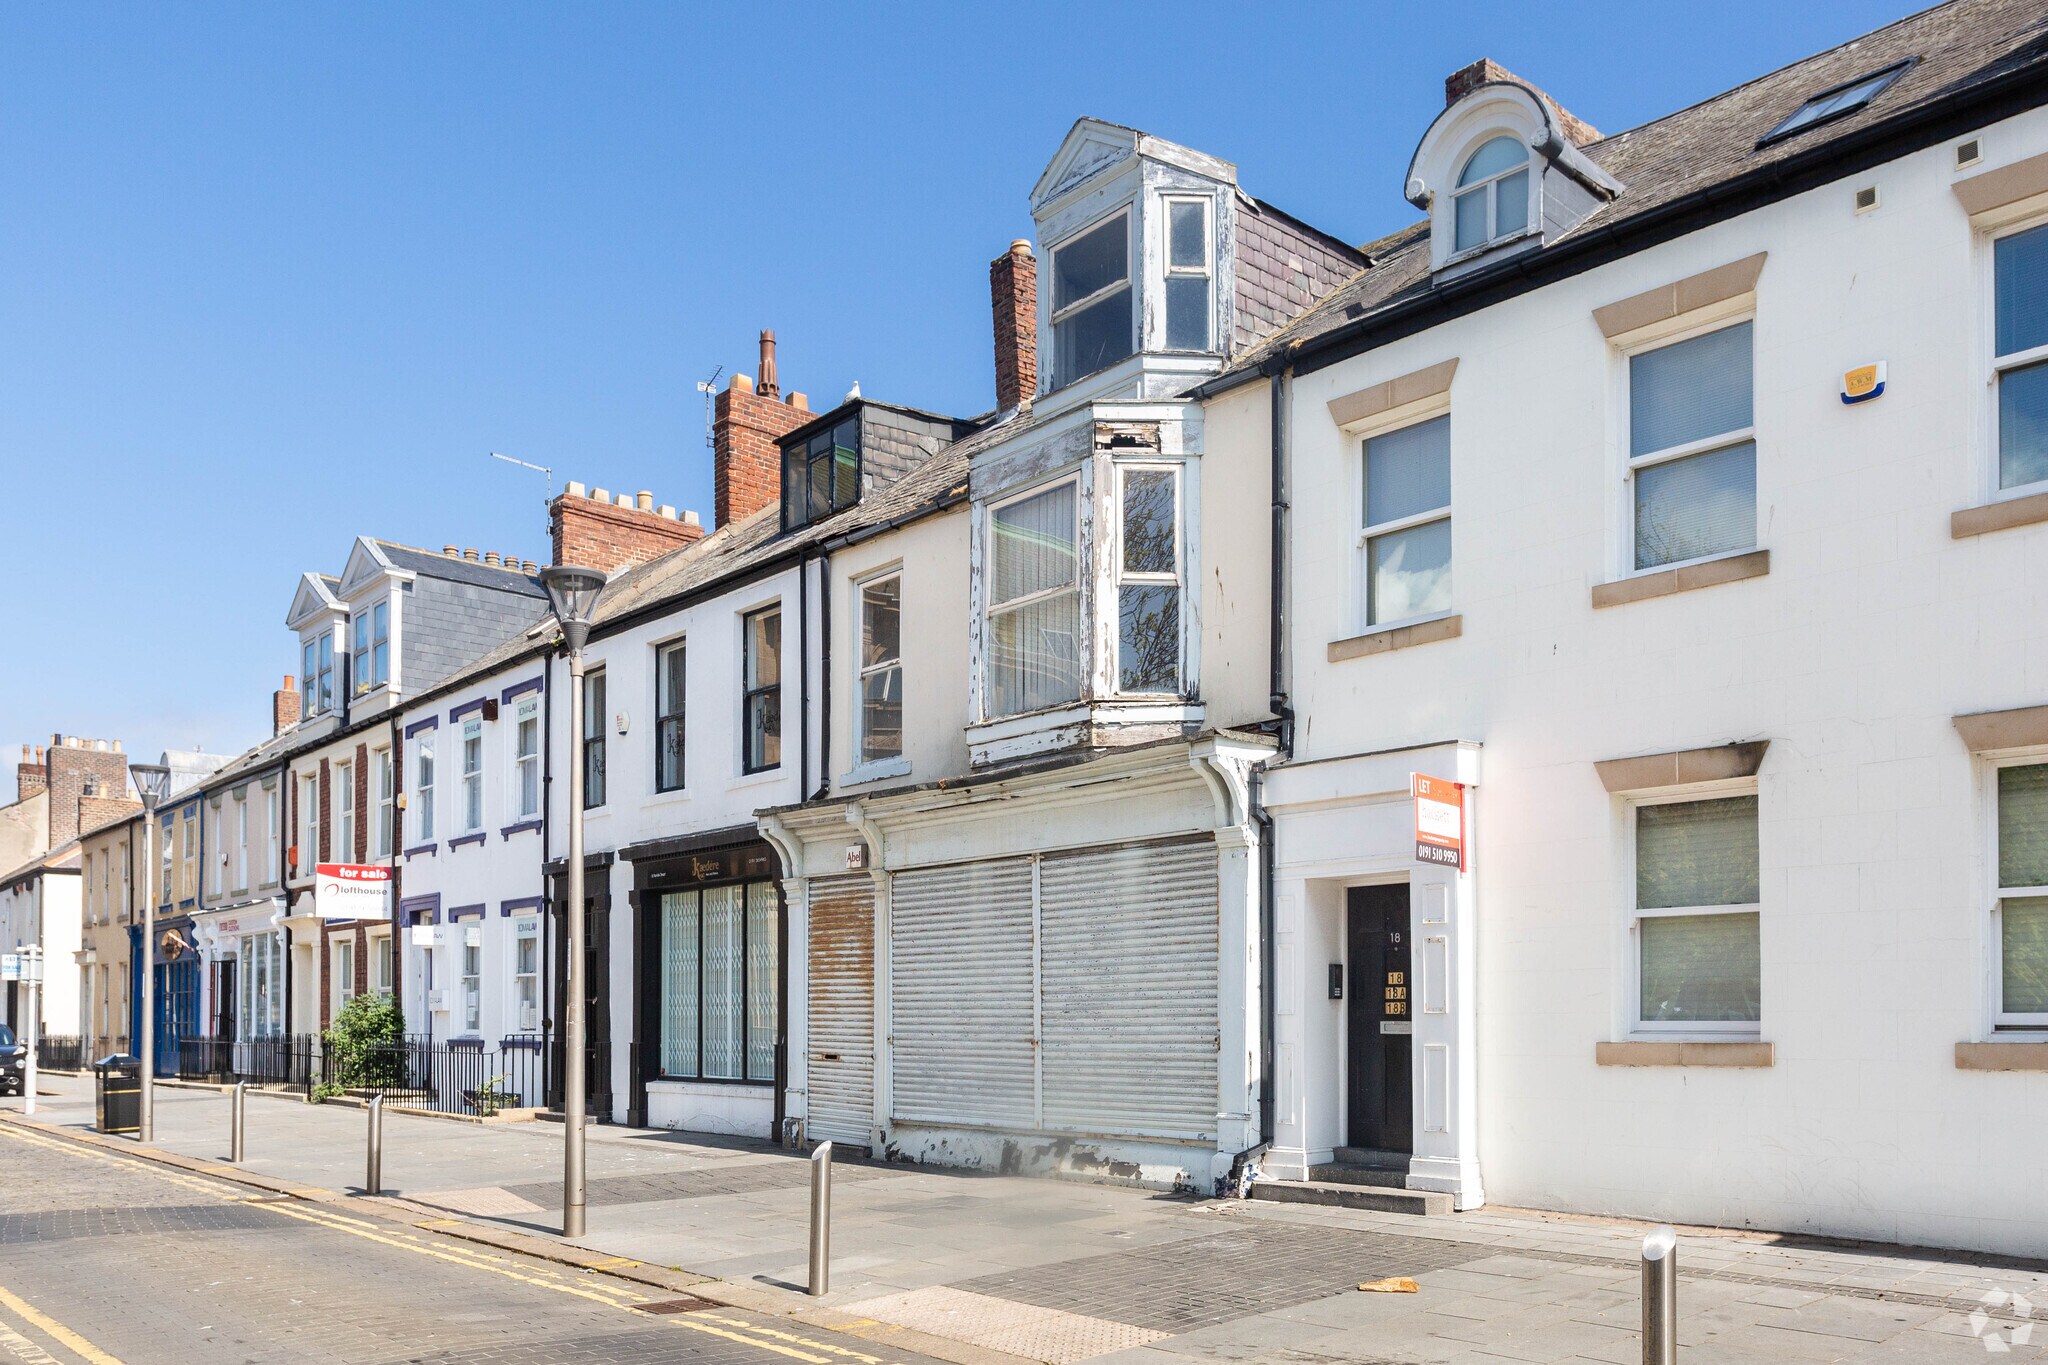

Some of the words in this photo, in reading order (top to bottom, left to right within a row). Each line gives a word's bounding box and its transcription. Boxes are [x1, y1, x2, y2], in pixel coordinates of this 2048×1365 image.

[1418, 778, 1431, 795] LET
[847, 850, 861, 863] Abel
[1418, 844, 1431, 859] 0191
[1432, 847, 1443, 861] 510
[1443, 849, 1458, 864] 9950
[339, 867, 358, 878] for
[361, 869, 388, 879] sale
[340, 886, 388, 896] lofthouse
[1390, 932, 1401, 943] 18
[1390, 973, 1402, 984] 18
[1387, 988, 1405, 999] 18A
[1387, 1002, 1406, 1014] 18B
